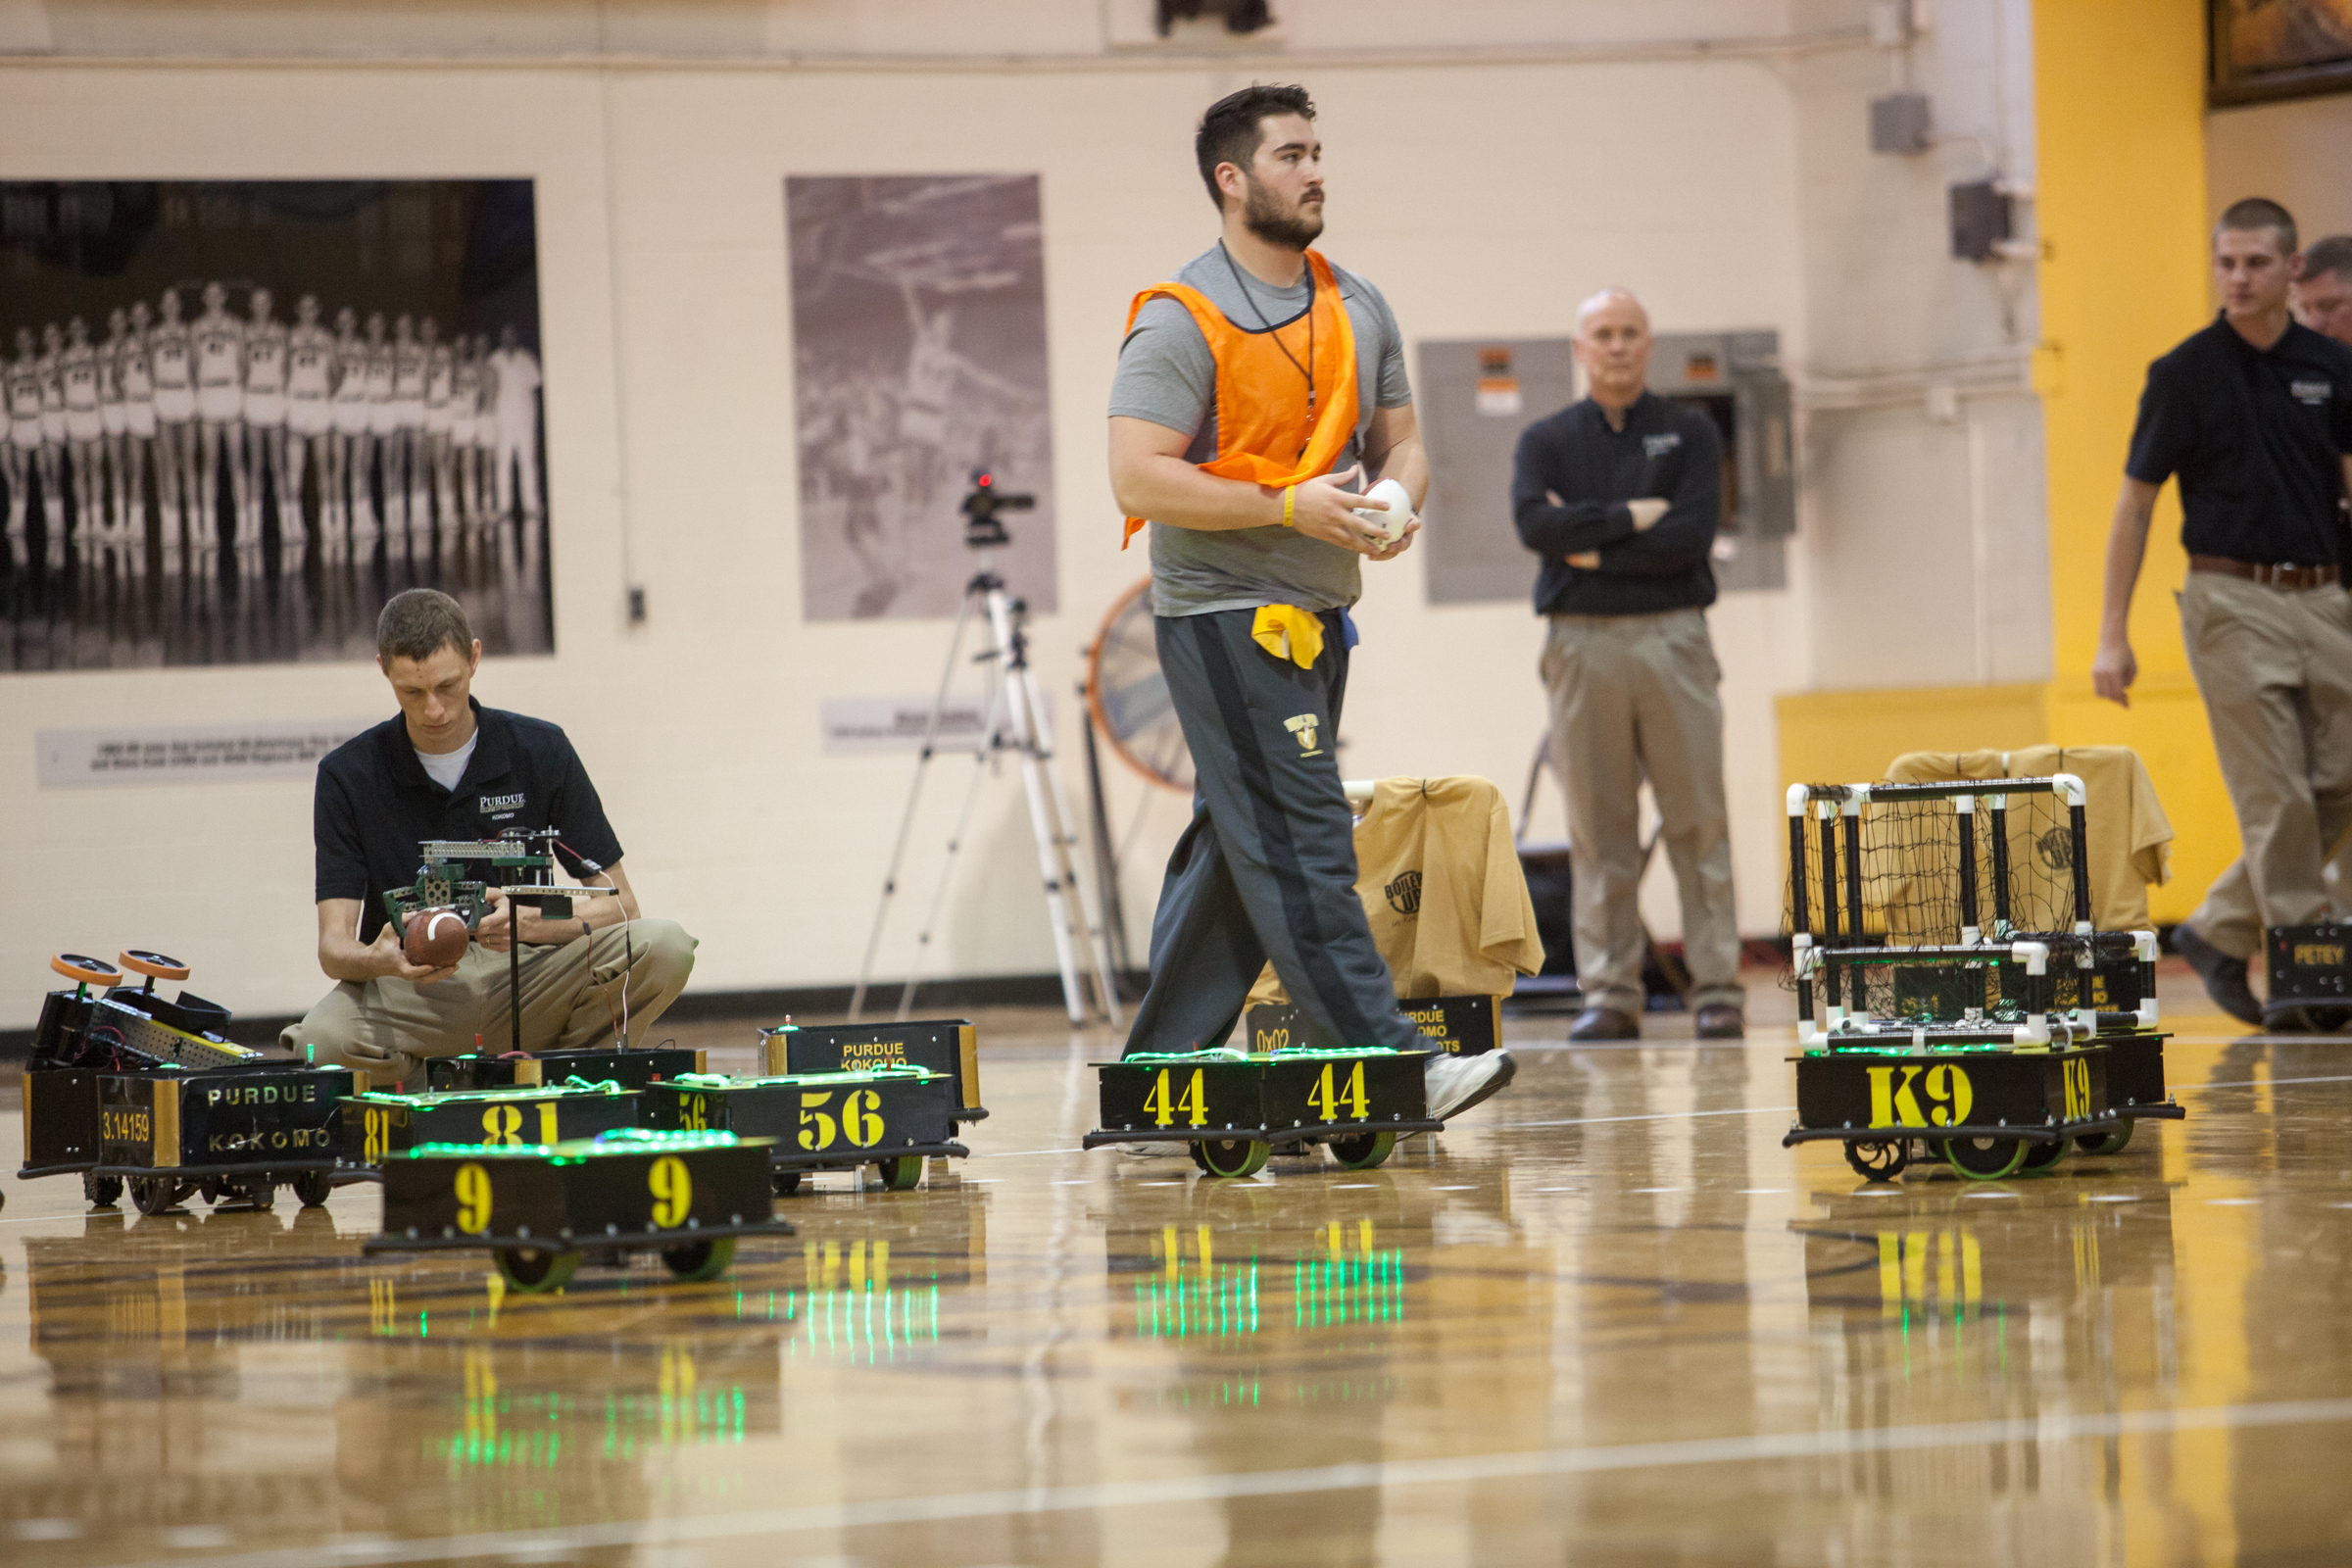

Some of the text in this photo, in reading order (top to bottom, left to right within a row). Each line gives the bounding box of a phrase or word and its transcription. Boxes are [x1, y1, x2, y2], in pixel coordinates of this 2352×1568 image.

[479, 793, 526, 808] PURDUE
[492, 812, 514, 821] KOKOMO
[2294, 945, 2344, 965] PETEY
[1404, 1009, 1445, 1023] RDUE
[1417, 1025, 1446, 1037] OMO
[843, 1042, 904, 1057] PURDUE
[1256, 1028, 1289, 1053] 0x02
[208, 1085, 316, 1106] PURDUE
[1143, 1068, 1209, 1125] 44
[1307, 1060, 1370, 1120] 44
[1866, 1063, 1973, 1129] K9
[2062, 1056, 2090, 1122] K9
[103, 1111, 149, 1142] 3.14159
[482, 1102, 559, 1145] 81
[679, 1092, 707, 1131] 56
[798, 1089, 885, 1151] 56
[209, 1129, 331, 1152] KOKOMO
[364, 1107, 390, 1165] 81
[454, 1162, 493, 1235] 9
[648, 1155, 693, 1228] 9
